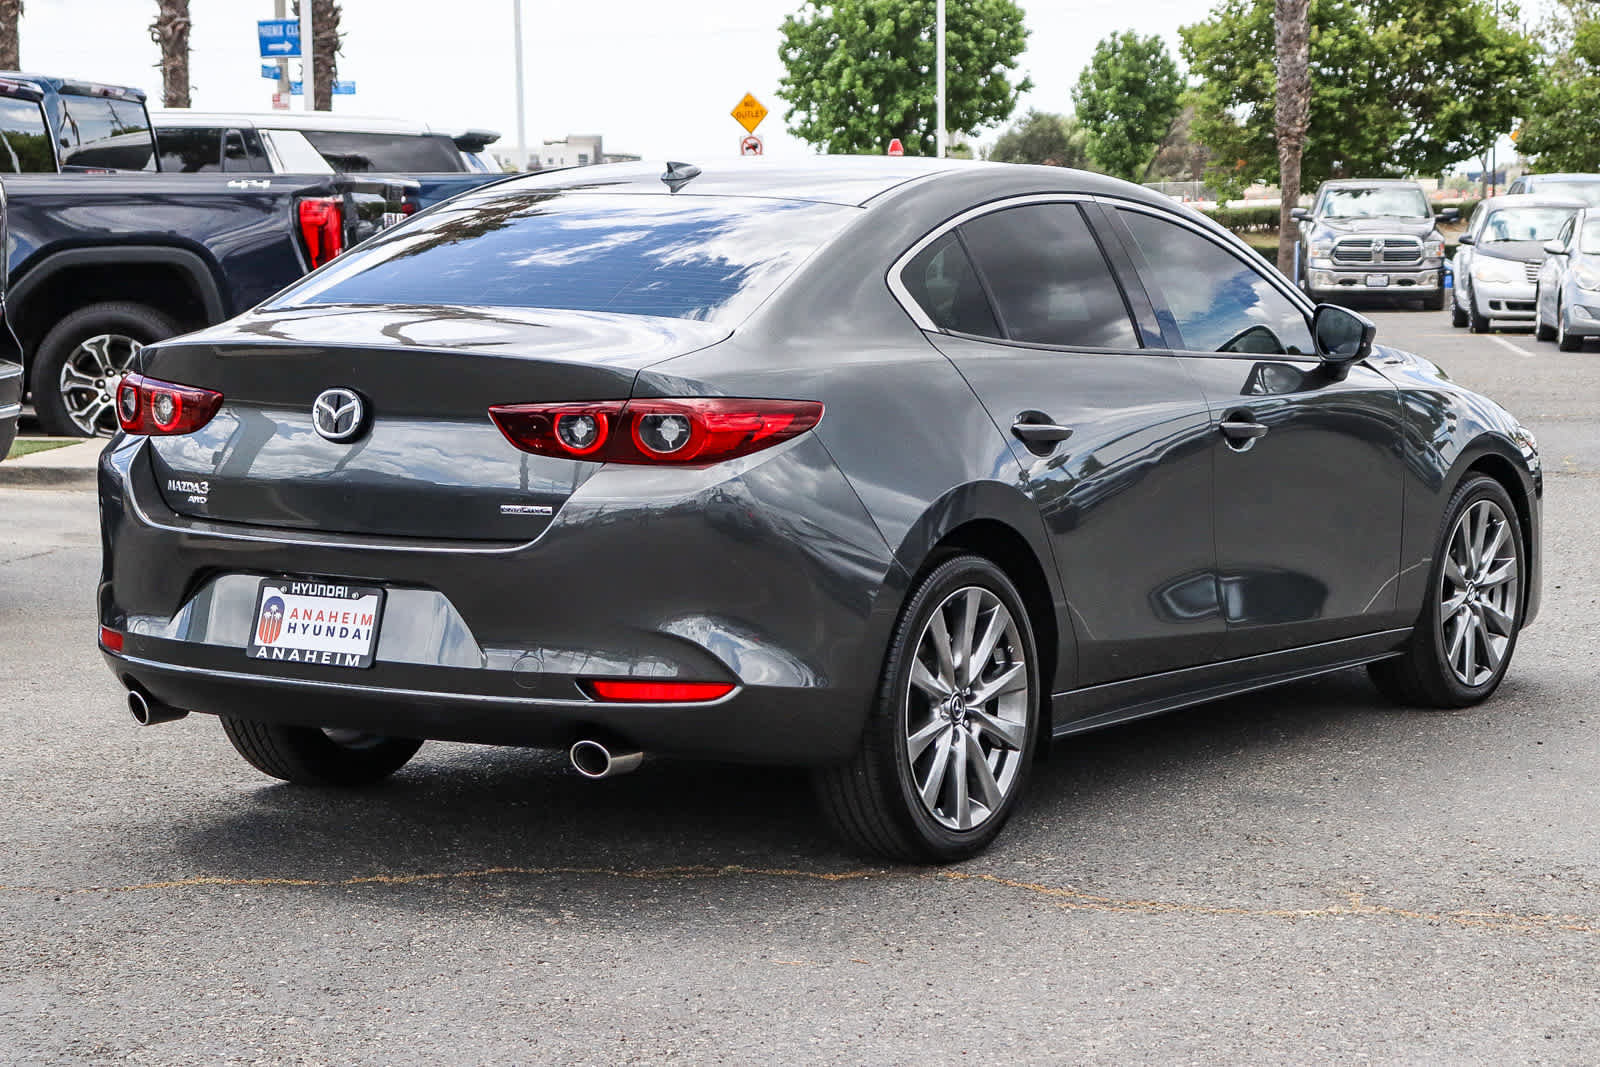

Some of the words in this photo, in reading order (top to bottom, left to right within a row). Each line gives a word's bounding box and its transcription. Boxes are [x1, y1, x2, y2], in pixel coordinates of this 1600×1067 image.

[736, 109, 764, 119] OUTLET
[167, 479, 209, 494] MAZDA3
[291, 582, 349, 598] HYUNDAI
[289, 607, 373, 626] ANAHEIM
[287, 622, 370, 641] HYUNDAI
[255, 646, 361, 667] ANAHEIM
